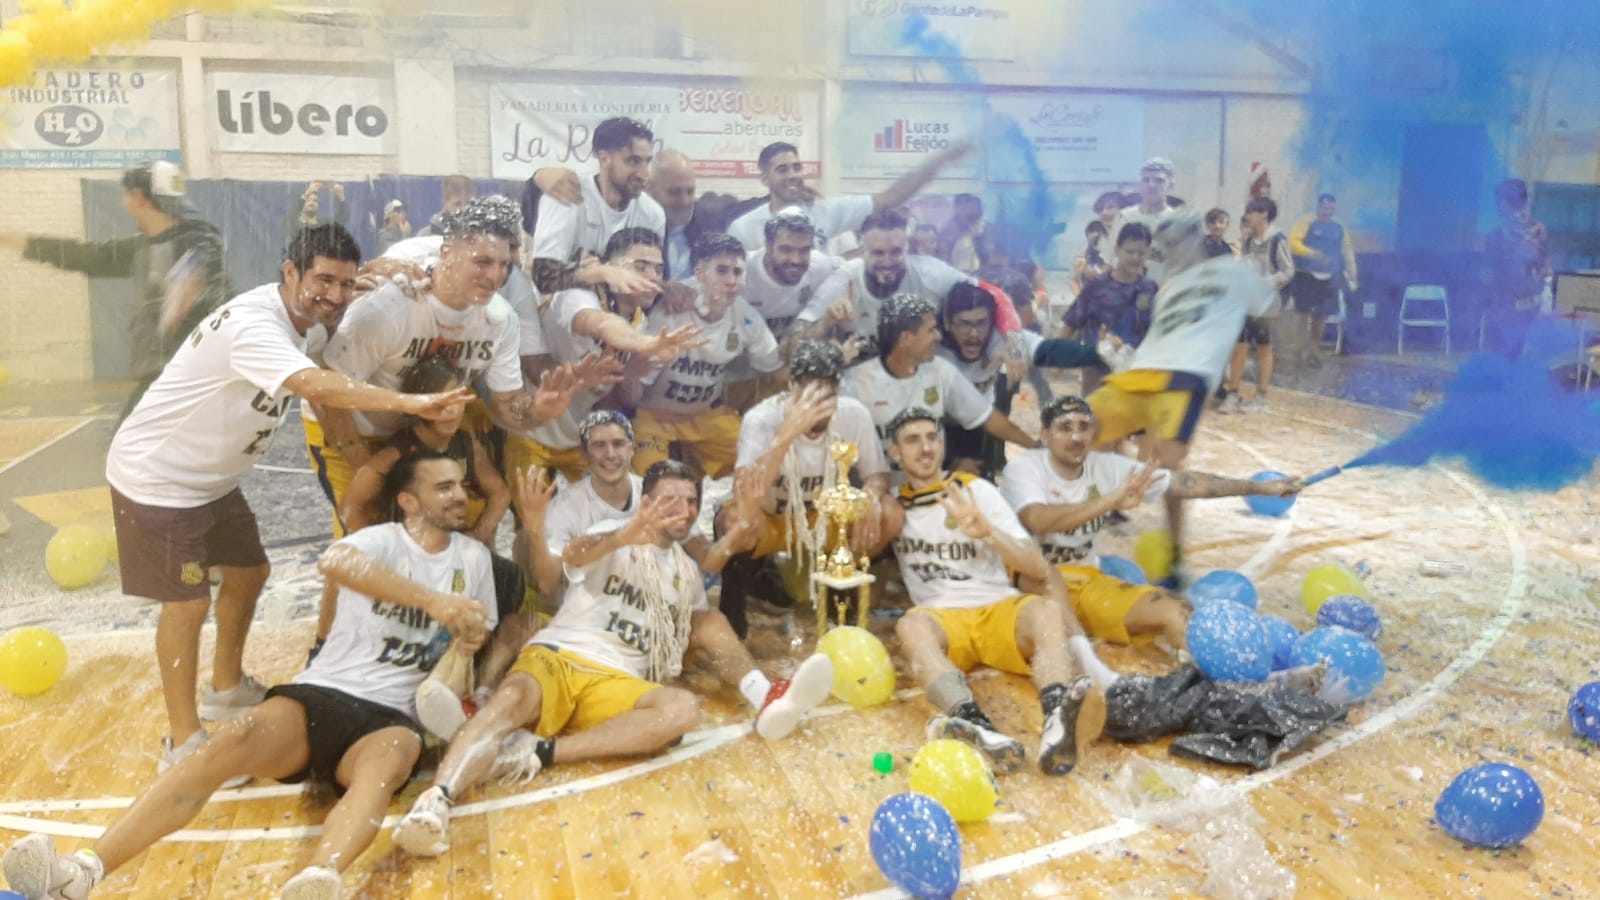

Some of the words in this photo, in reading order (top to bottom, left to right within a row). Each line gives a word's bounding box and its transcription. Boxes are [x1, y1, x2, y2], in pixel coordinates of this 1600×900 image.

[10, 88, 130, 104] INDUSTRIAL
[723, 121, 803, 138] aberturas
[904, 119, 950, 134] Lucas
[502, 121, 551, 164] La
